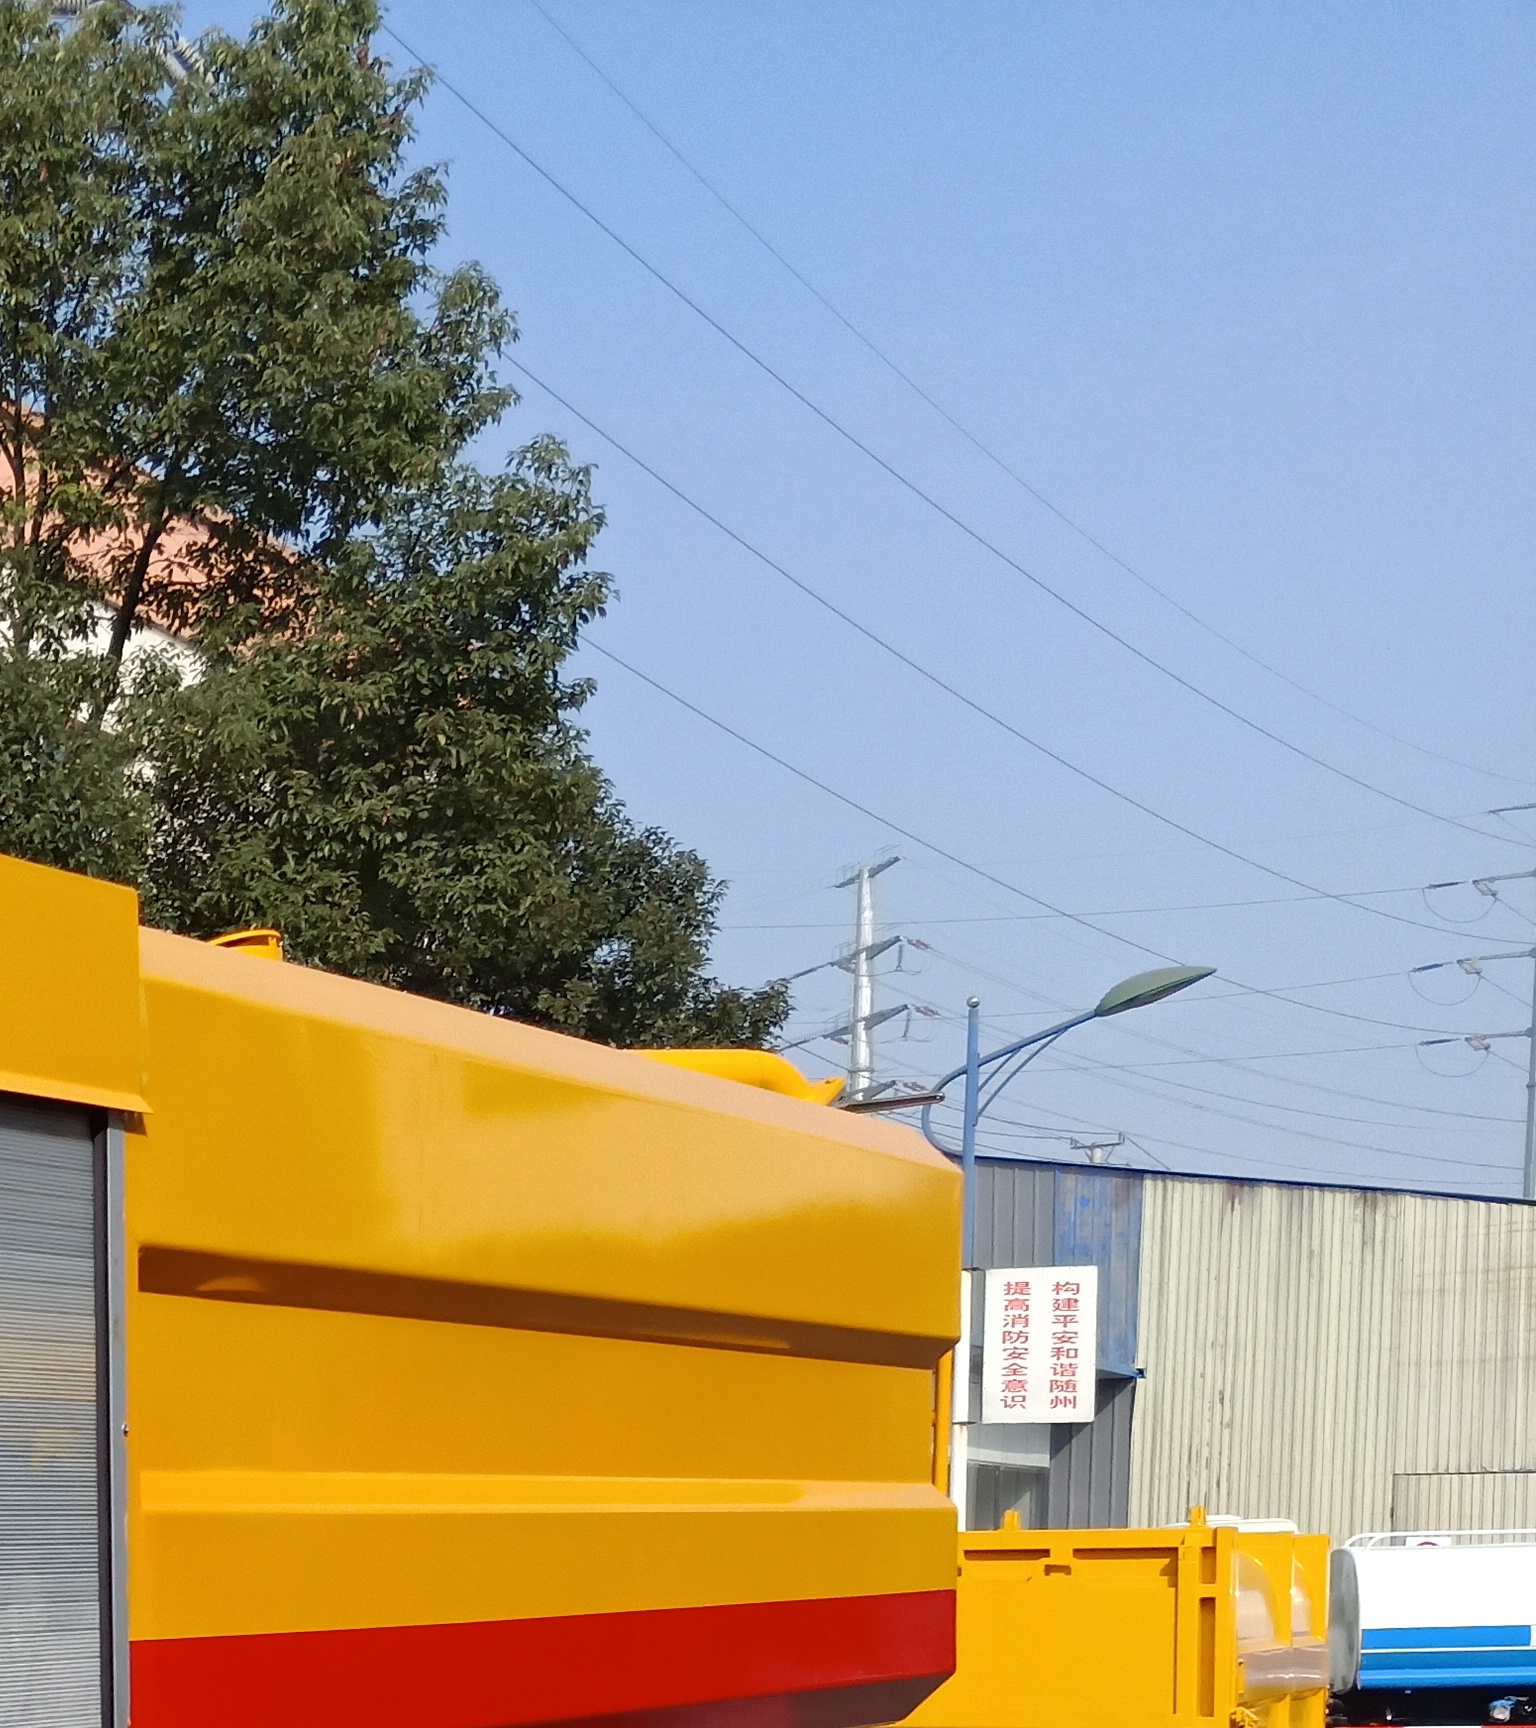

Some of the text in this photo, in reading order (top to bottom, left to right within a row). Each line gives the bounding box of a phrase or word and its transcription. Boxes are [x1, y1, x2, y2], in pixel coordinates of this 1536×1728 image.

[1000, 1281, 1031, 1409] 提高消防安全意识
[1049, 1281, 1080, 1409] 构建平安和谐随州
